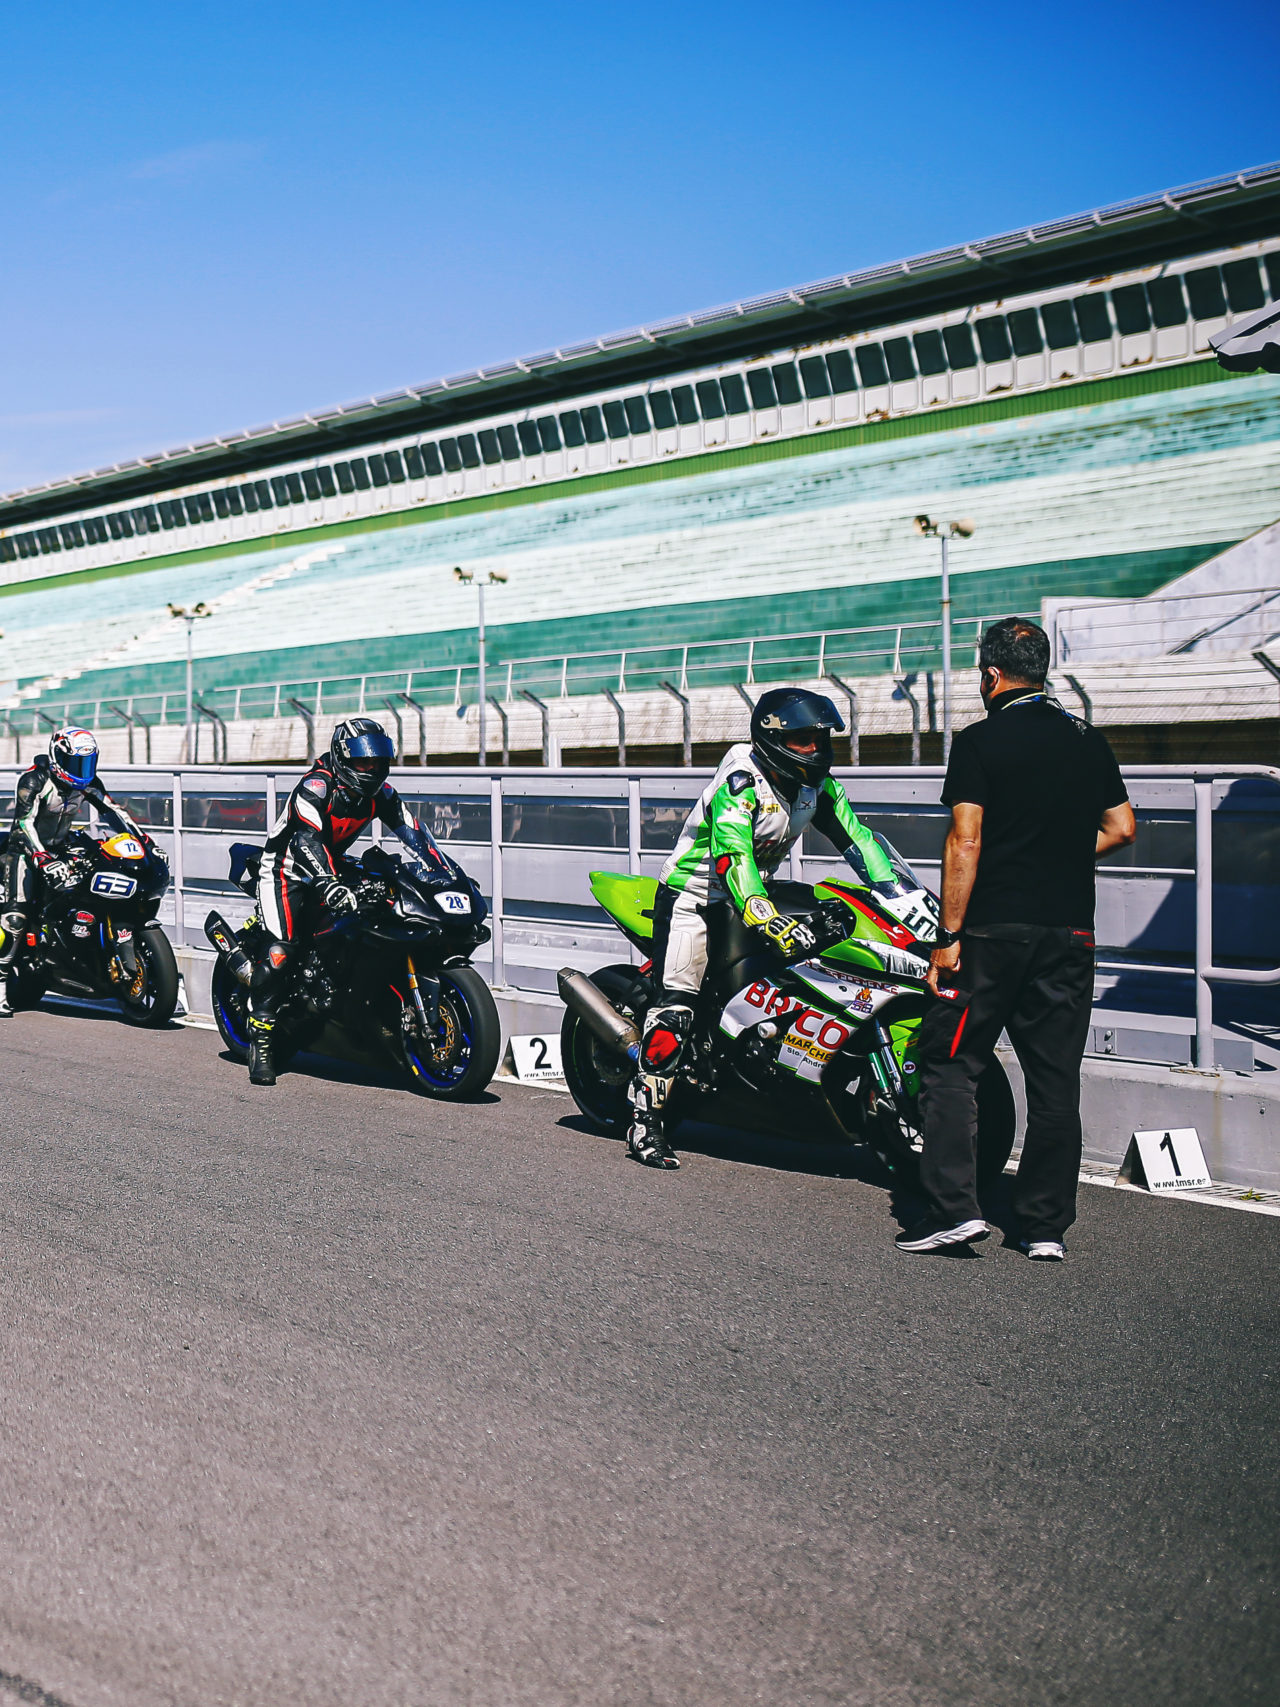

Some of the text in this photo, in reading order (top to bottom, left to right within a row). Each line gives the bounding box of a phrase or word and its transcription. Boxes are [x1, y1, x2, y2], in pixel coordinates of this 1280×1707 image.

[124, 842, 139, 853] 72
[92, 874, 136, 898] 63
[445, 896, 464, 909] 28
[744, 979, 850, 1050] BRCO
[529, 1037, 553, 1070] 2
[785, 1034, 833, 1061] MARCHE
[1159, 1132, 1182, 1177] 1
[1153, 1178, 1207, 1189] www.tmsr.es
